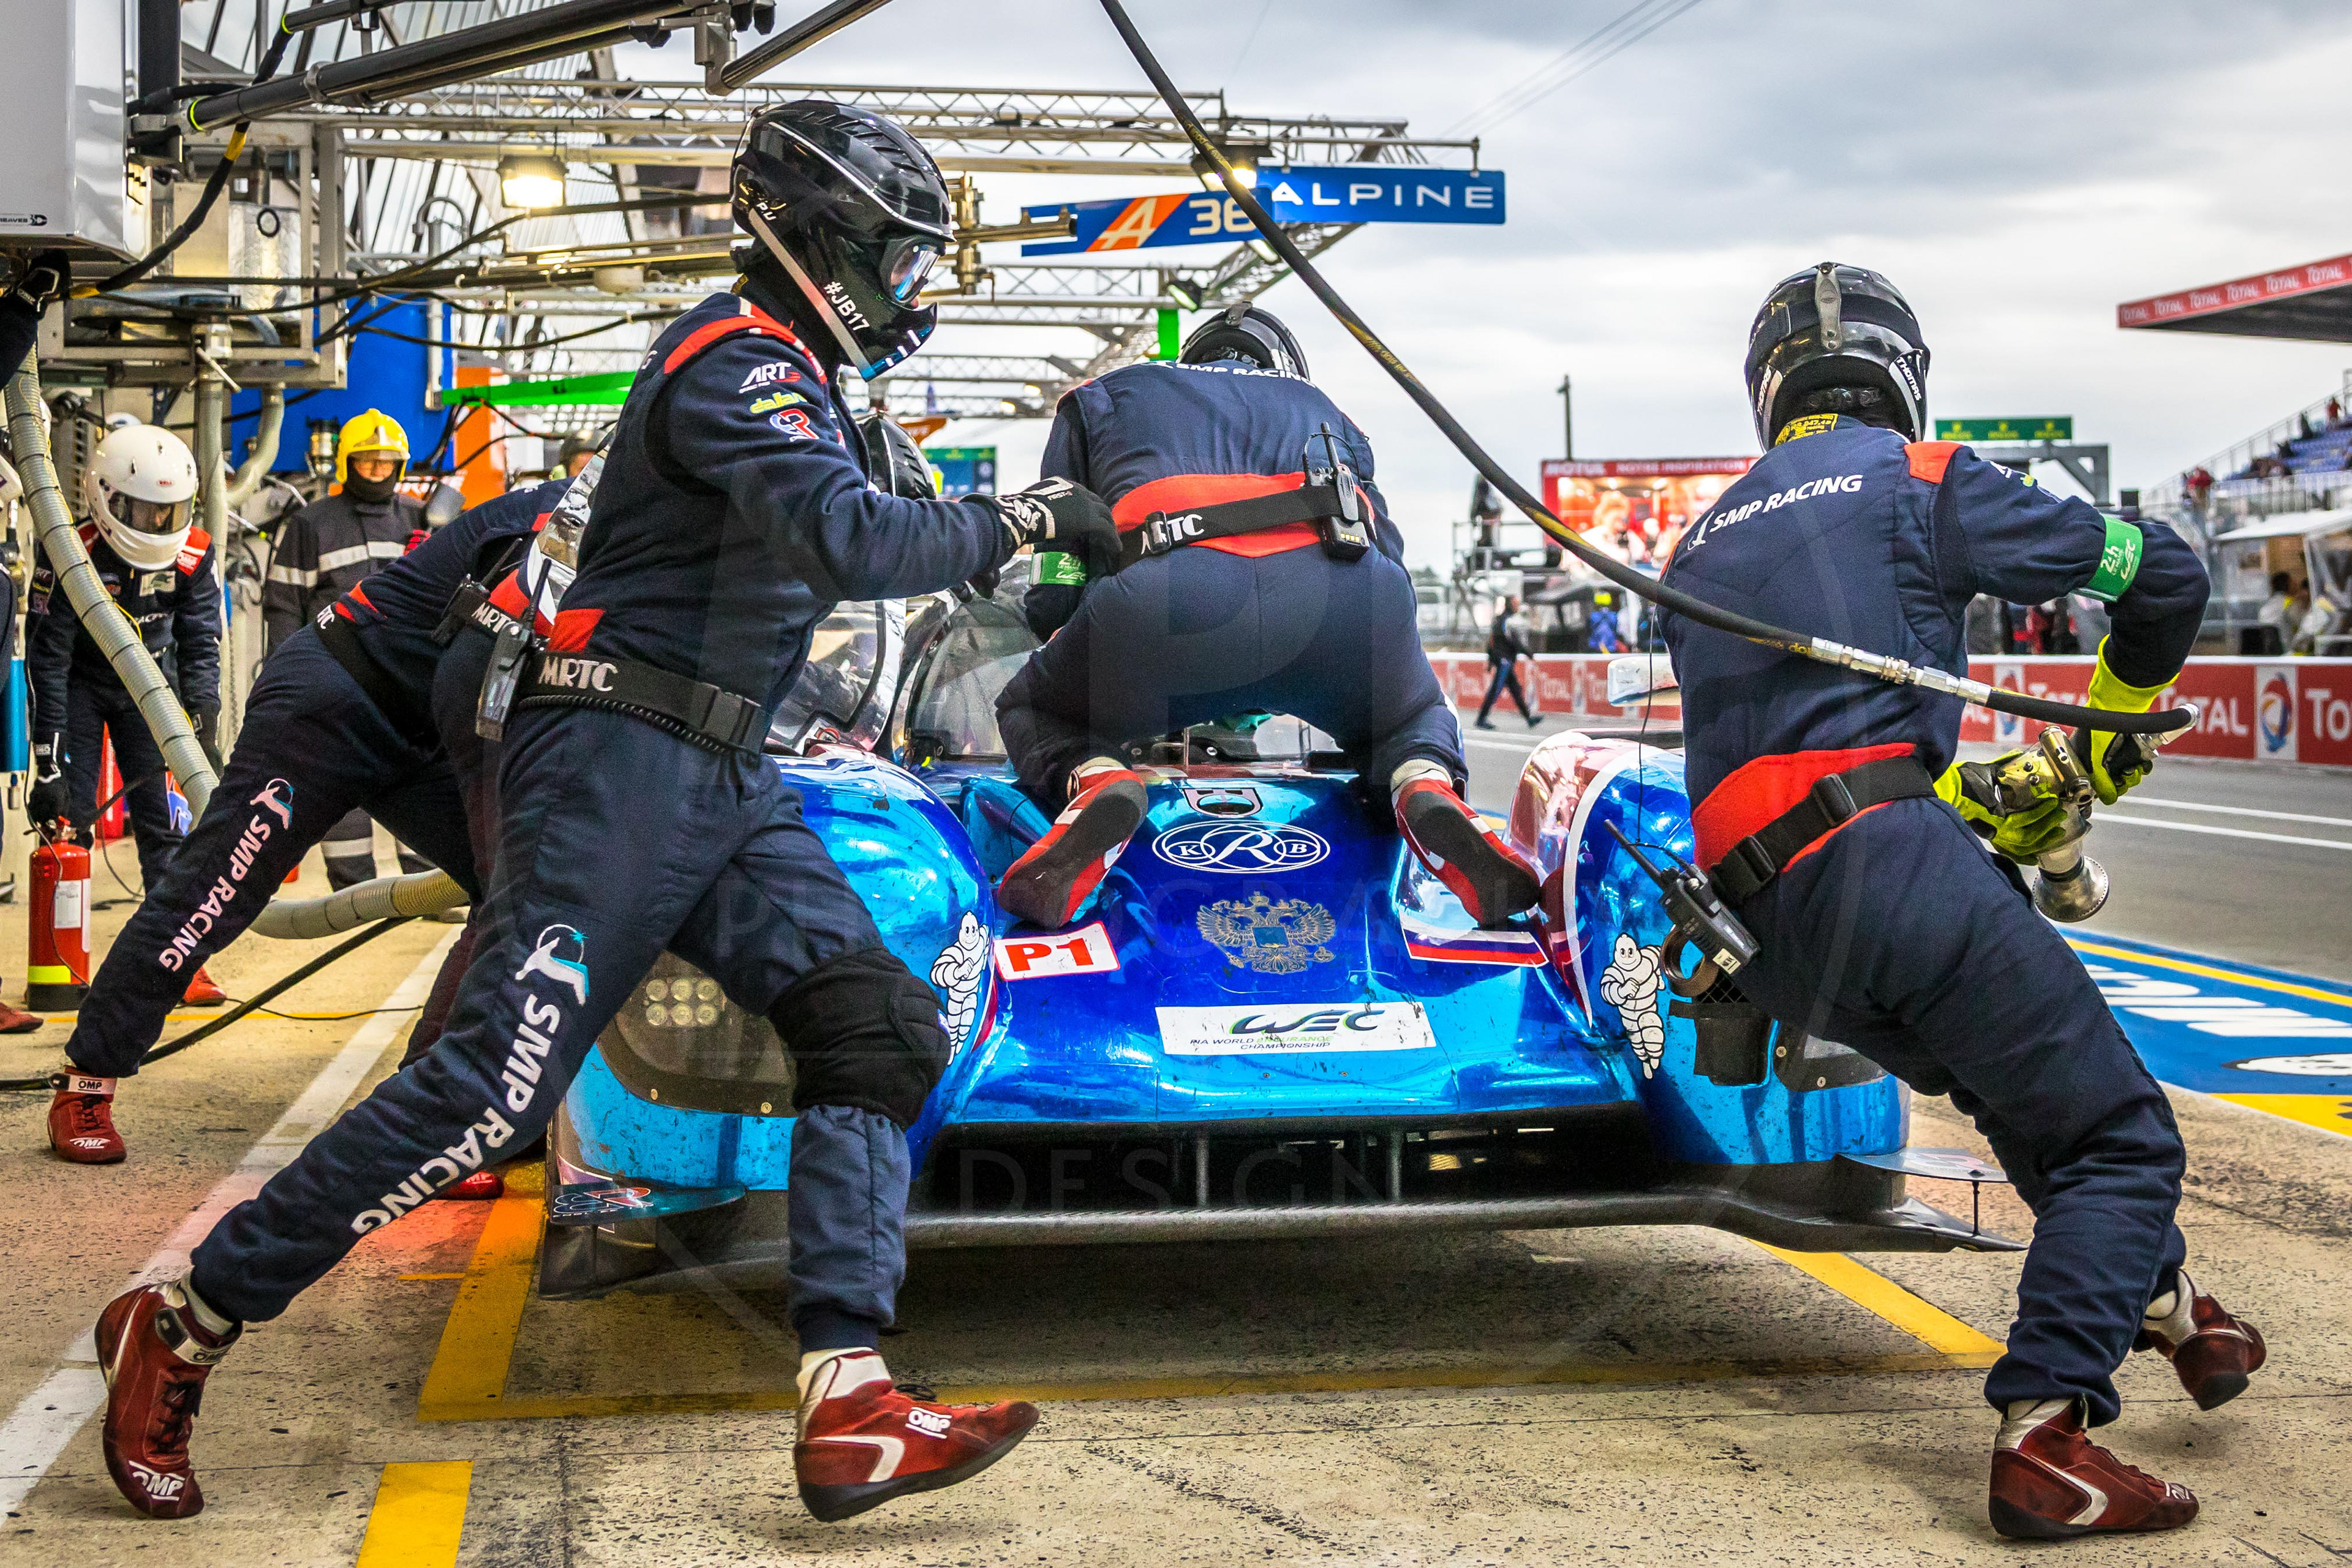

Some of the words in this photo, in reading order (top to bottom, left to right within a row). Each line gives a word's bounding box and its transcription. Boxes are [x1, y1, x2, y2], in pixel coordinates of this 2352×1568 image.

[1272, 181, 1494, 209] ALPINE
[2265, 274, 2300, 292] TOTAL
[2306, 265, 2343, 284] TOTAL
[2188, 290, 2221, 307] TOTAL
[2226, 282, 2260, 300] TOTAL
[824, 281, 870, 331] #JB17
[2154, 299, 2184, 315] TOTAL
[741, 361, 792, 387] ART
[1176, 363, 1228, 373] SMP
[1232, 368, 1316, 388] RACING
[1896, 356, 1922, 401] THOMAS
[1545, 462, 1605, 475] MOTUL
[1709, 500, 1763, 533] SMP
[1762, 474, 1863, 513] RACING
[538, 656, 619, 692] MRTC
[229, 814, 271, 881] SMP
[158, 875, 238, 973] RACING
[1012, 939, 1094, 971] P1
[1229, 1009, 1386, 1035] WEC
[501, 993, 560, 1114] SMP
[1240, 1042, 1331, 1050] CHAMPIONSHIP
[78, 1080, 103, 1090] OMP
[350, 1106, 515, 1235] RACING
[908, 1410, 951, 1432] OMP
[132, 1471, 184, 1496] OMP
